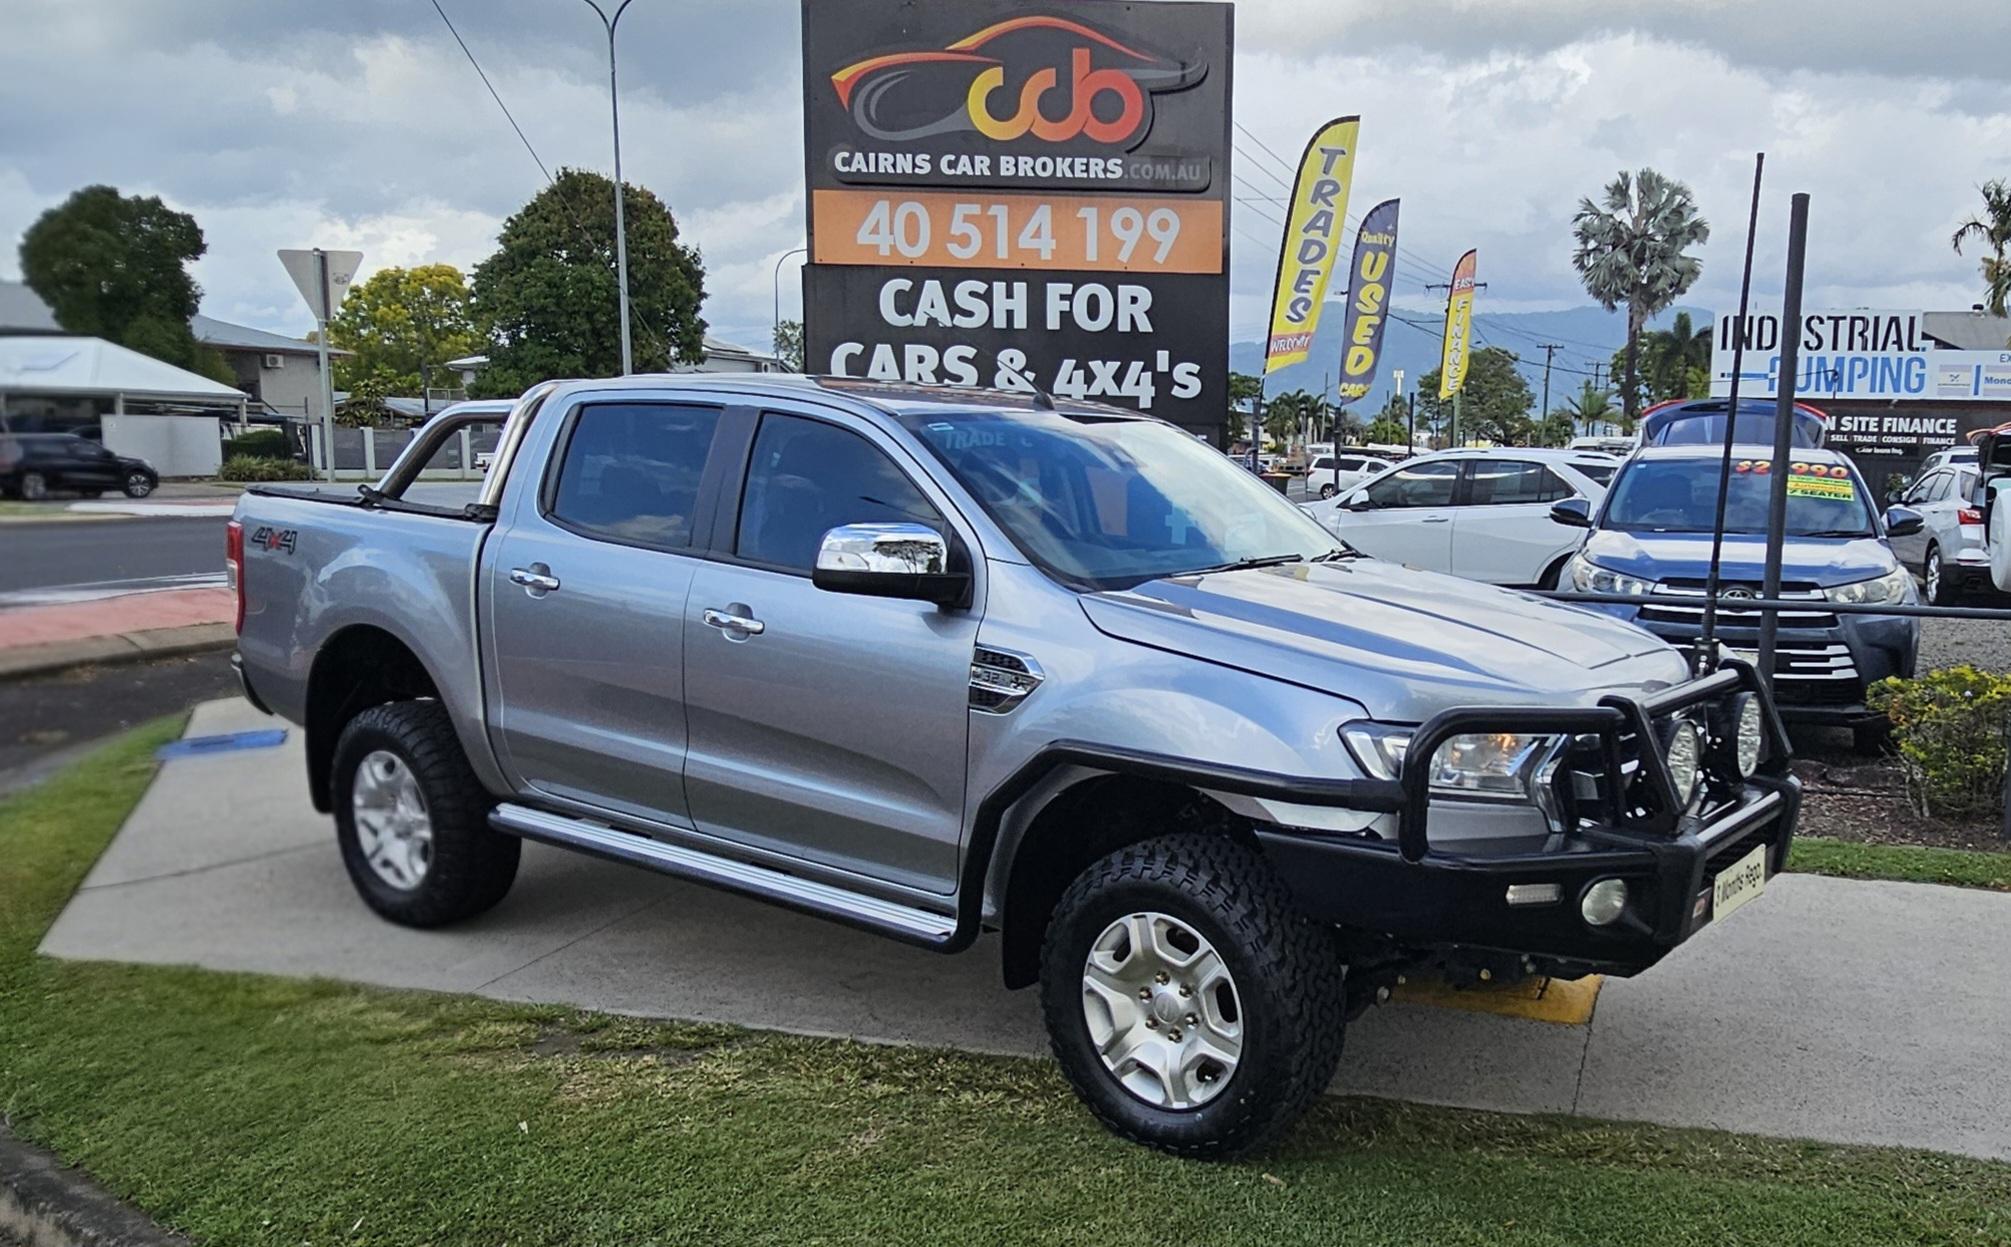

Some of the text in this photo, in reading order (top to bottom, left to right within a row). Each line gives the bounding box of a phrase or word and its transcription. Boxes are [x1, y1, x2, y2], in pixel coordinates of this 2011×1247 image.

[834, 151, 931, 175] CAIRNS
[940, 154, 991, 176] CAR
[857, 201, 1181, 264] 40 514 199
[1285, 147, 1347, 324] TRADES
[1361, 231, 1395, 247] Quality
[879, 278, 1153, 333] CASH FOR
[1345, 250, 1389, 376] USED
[1447, 300, 1469, 391] FINANCE
[1721, 315, 1921, 351] INDSTRIAL
[830, 342, 978, 387] CARS
[994, 349, 1036, 393] &
[945, 427, 1006, 450] TRADE
[1830, 434, 1956, 445] SELL TRADE CONSIGN FINANCE
[1840, 416, 1879, 432] SITE
[1883, 418, 1957, 434] FINANCE
[1801, 490, 1851, 499] SEATER
[1721, 872, 1744, 904] Months
